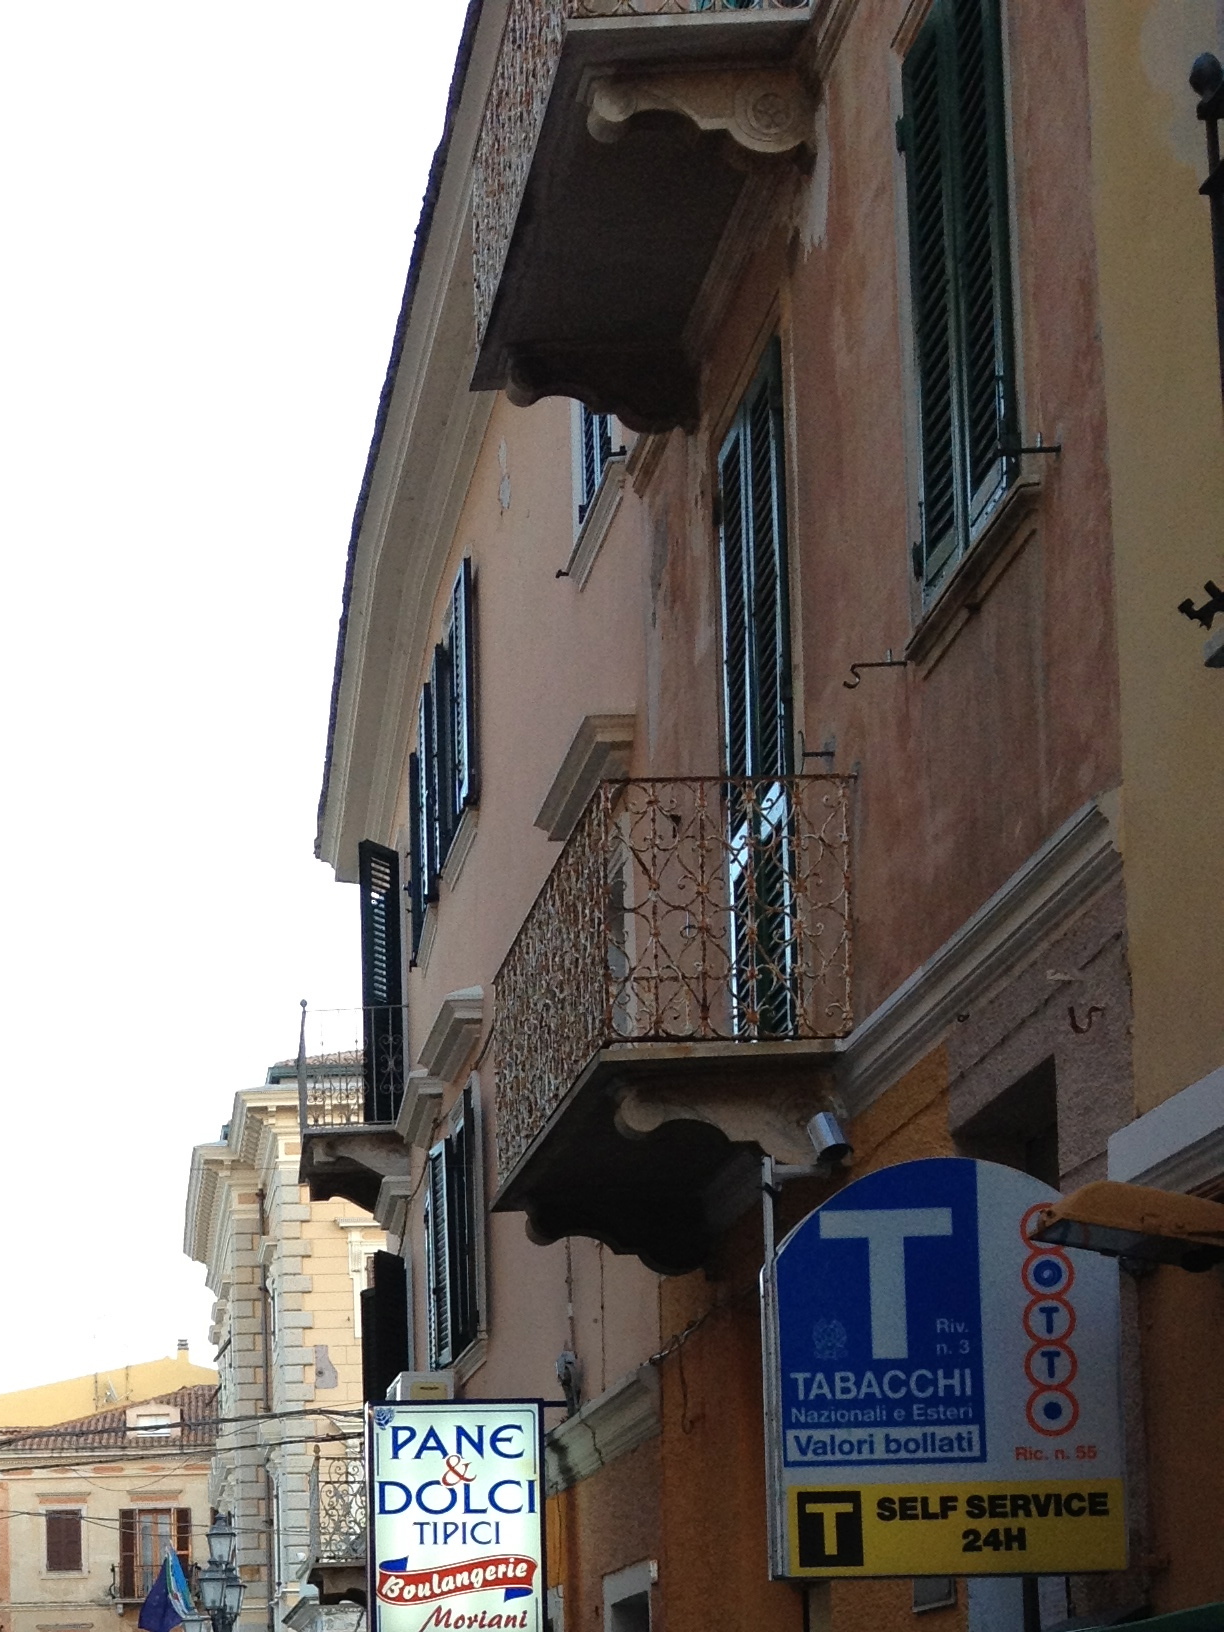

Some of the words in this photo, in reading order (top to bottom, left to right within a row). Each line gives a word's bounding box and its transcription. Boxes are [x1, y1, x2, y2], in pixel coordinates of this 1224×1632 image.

[819, 1207, 953, 1360] T
[936, 1318, 970, 1333] Riv.
[936, 1343, 953, 1356] n.
[959, 1339, 971, 1354] 3
[790, 1368, 973, 1401] TABACCHI
[791, 1405, 887, 1423] Nazionali
[893, 1409, 906, 1421] e
[913, 1403, 973, 1420] Esteri
[389, 1424, 526, 1460] PANE
[793, 1434, 875, 1457] Valori
[884, 1431, 974, 1454] bollati
[1015, 1446, 1049, 1460] Ric.
[1055, 1449, 1071, 1460] n.
[1076, 1446, 1097, 1460] 55
[440, 1454, 477, 1487] &
[376, 1479, 538, 1515] DOLCI
[876, 1496, 958, 1521] SELF
[965, 1492, 1110, 1519] SERVICE
[413, 1521, 501, 1545] TIPICI
[805, 1502, 854, 1556] T
[962, 1527, 1026, 1552] 24H
[382, 1558, 528, 1599] Boulangerie
